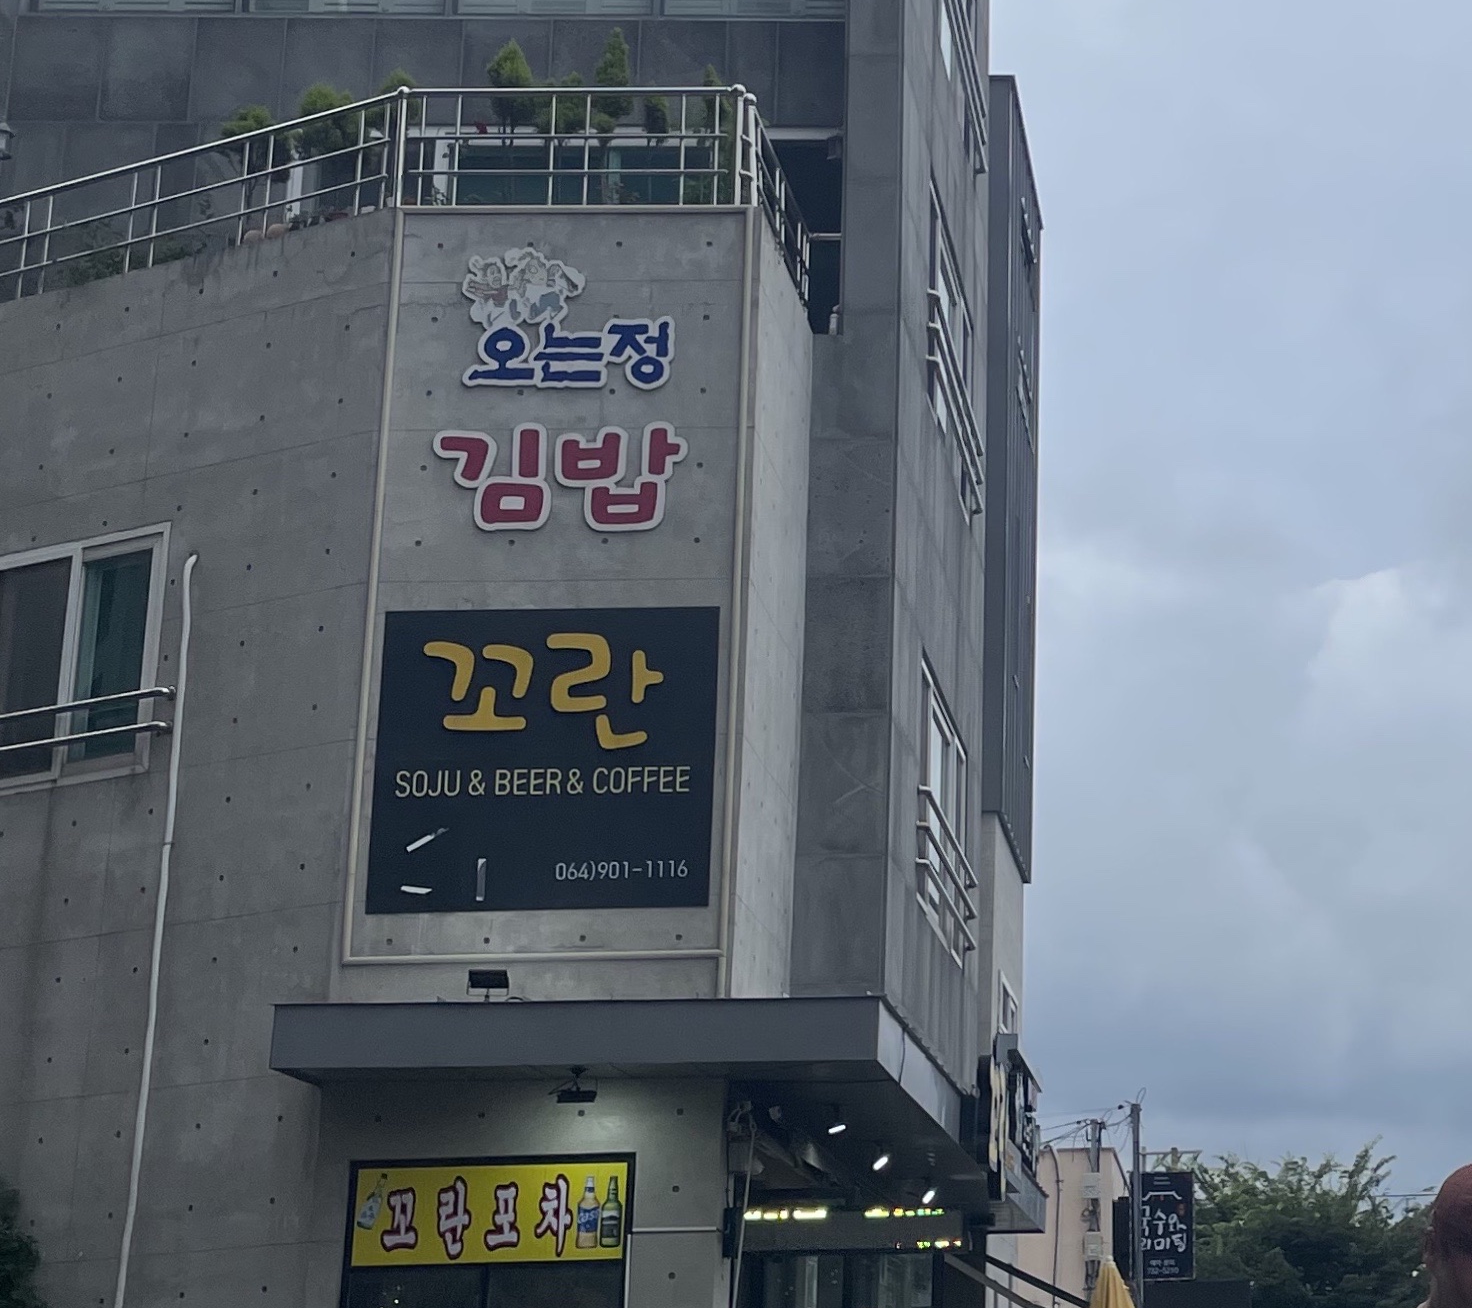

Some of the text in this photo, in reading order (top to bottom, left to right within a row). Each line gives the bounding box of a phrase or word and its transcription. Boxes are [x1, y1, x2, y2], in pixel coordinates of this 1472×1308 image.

[465, 319, 674, 386] 오는정
[436, 424, 687, 530] 김밥
[423, 633, 664, 749] 꼬란
[395, 766, 691, 797] SOJU & BEER & COFFEE
[555, 859, 688, 881] 064)901-1116
